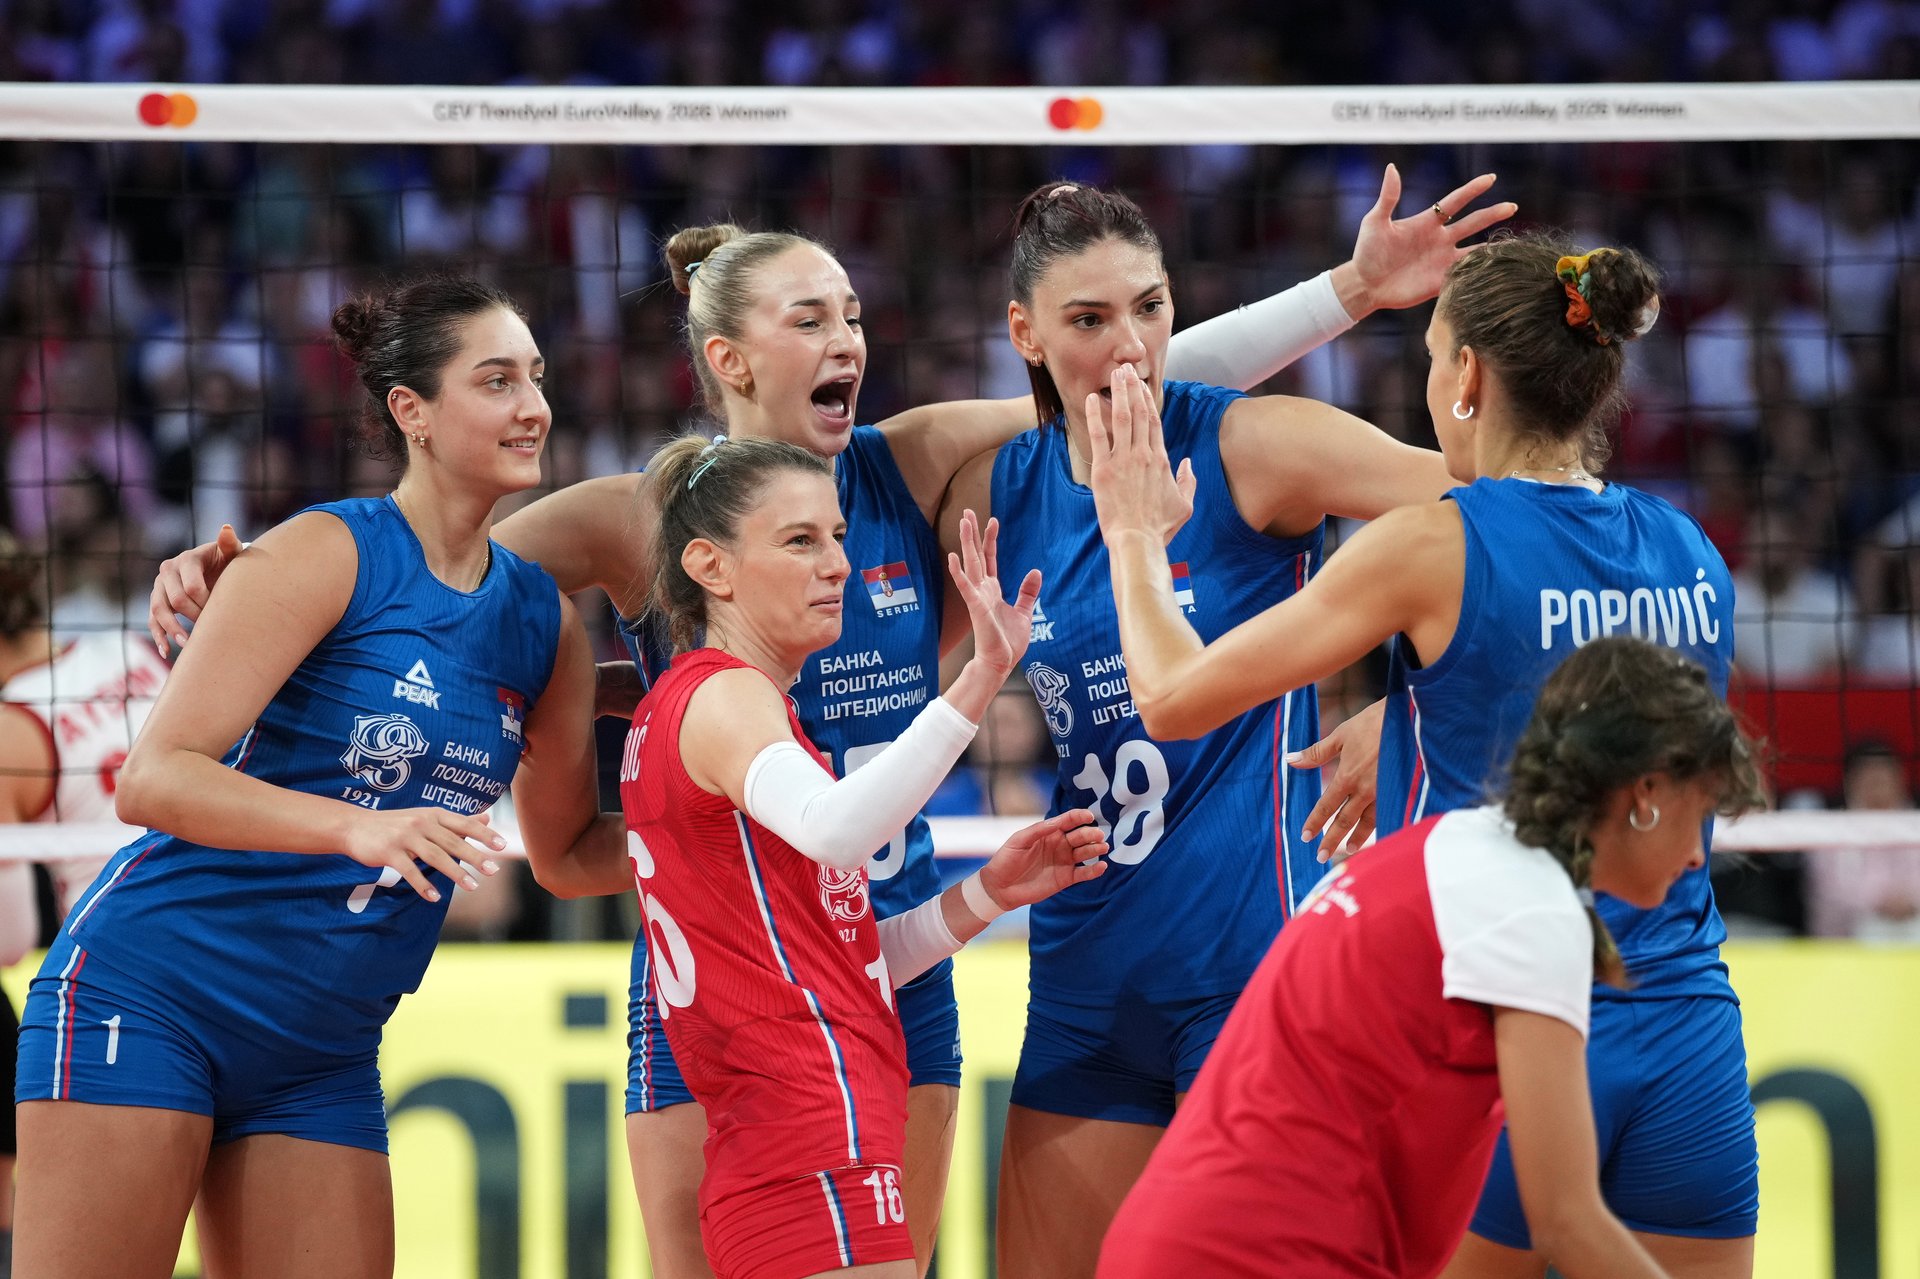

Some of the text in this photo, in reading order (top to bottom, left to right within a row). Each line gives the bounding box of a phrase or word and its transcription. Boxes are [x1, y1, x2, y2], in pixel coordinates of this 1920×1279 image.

[433, 102, 472, 121] CEV
[480, 102, 556, 122] Trendyol
[564, 102, 661, 122] EuroVolley
[718, 102, 789, 121] Women
[1332, 101, 1371, 121] CEV
[1462, 101, 1557, 122] EuroVolley
[1613, 100, 1686, 120] Women
[876, 602, 920, 618] SERBIA
[1540, 567, 1720, 650] POPOVIĆ
[819, 650, 884, 675] БАНКА
[1081, 653, 1127, 679] БАНК
[821, 663, 923, 698] ПОШТАНСКА
[1087, 676, 1129, 702] ПОШ
[392, 680, 442, 711] PEAK
[823, 685, 927, 721] ШТЕДИОНИЦА
[1092, 699, 1140, 726] ШТЕД
[443, 741, 490, 769] БАНКА
[431, 763, 507, 797] ПОШТАНСК
[340, 786, 381, 811] 1921
[1072, 739, 1170, 866] 18
[838, 927, 857, 943] 921
[100, 1014, 122, 1066] 1
[862, 1170, 905, 1225] 16
